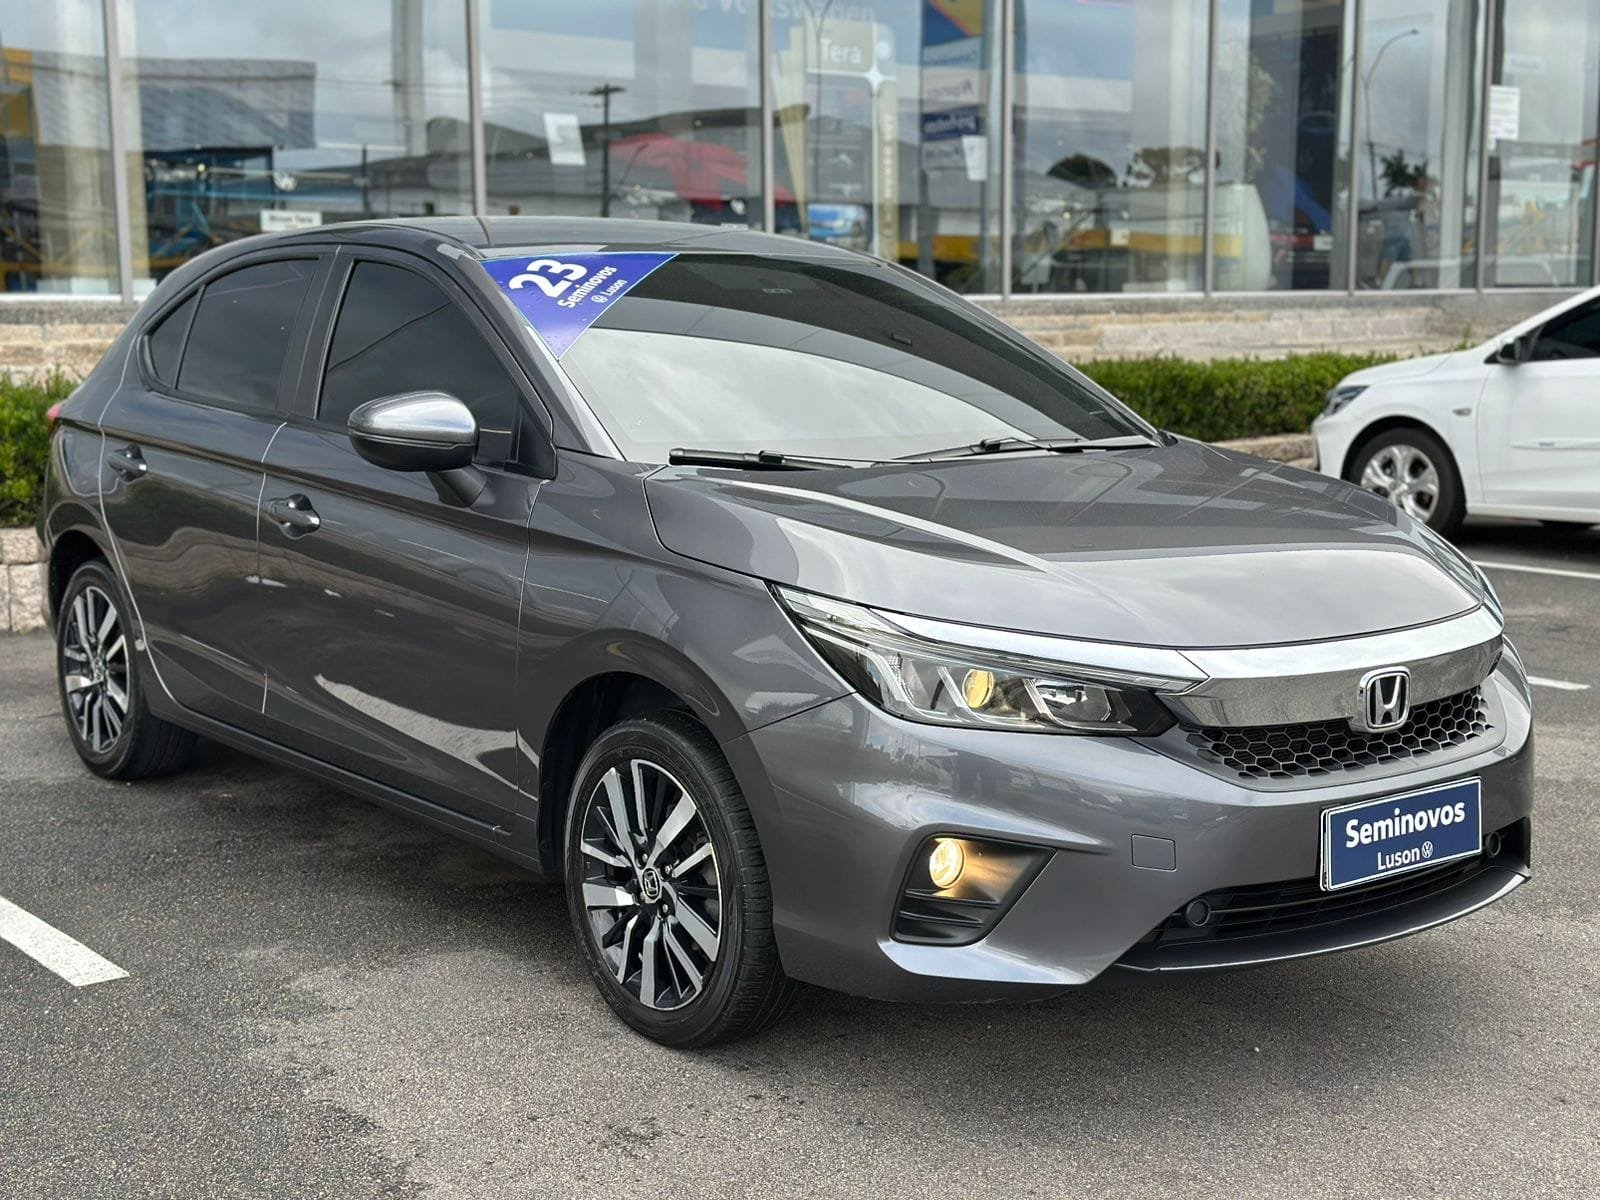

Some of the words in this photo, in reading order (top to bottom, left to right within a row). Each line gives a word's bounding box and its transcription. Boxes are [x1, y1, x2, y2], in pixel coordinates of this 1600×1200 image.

[819, 37, 862, 64] Tera
[508, 259, 588, 297] 23
[557, 265, 618, 308] Seminovos
[601, 279, 627, 297] Luson
[1345, 802, 1466, 848] Seminovos
[1377, 847, 1420, 871] Luson
